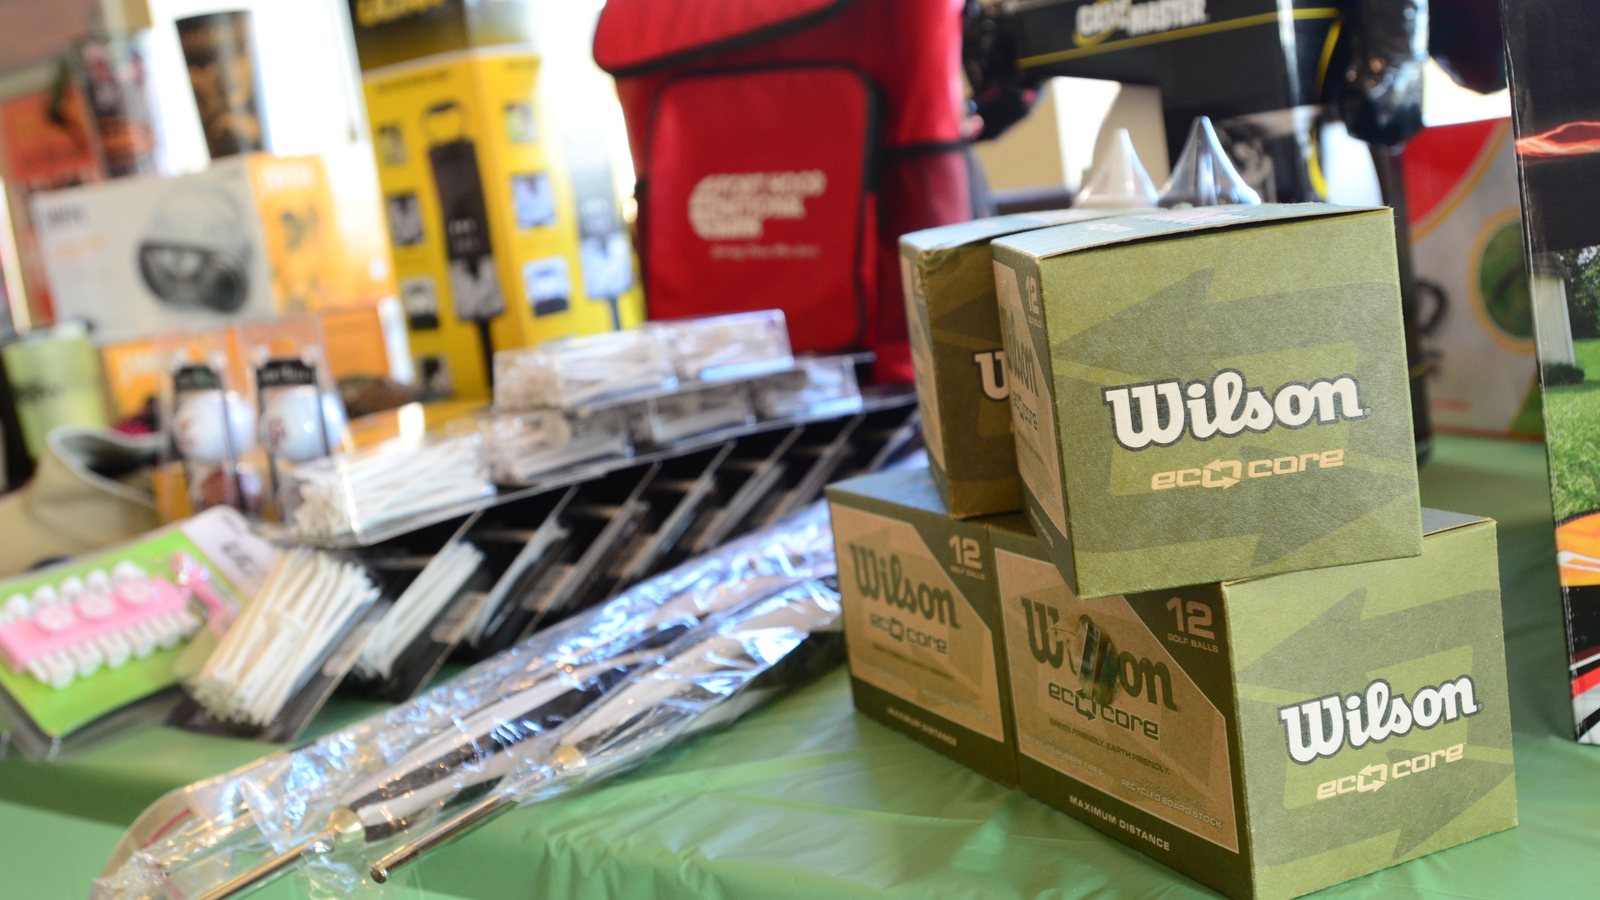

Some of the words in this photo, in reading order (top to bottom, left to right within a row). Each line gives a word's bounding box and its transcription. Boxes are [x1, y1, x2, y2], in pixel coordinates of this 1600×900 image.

[1025, 275, 1040, 315] 12
[1103, 369, 1365, 451] Wilson
[1248, 449, 1345, 479] core
[948, 535, 983, 569] 12
[850, 544, 961, 629] Wilson
[1166, 596, 1216, 640] 12
[907, 627, 948, 655] core
[1021, 596, 1178, 712] Won
[1167, 632, 1192, 645] GOLF
[1191, 638, 1219, 653] BALLS
[1101, 704, 1159, 741] core
[1278, 674, 1480, 765] Wilson
[1392, 743, 1464, 779] core
[1069, 794, 1118, 825] MAXIMUM
[1118, 818, 1171, 851] DISTANCE
[1192, 809, 1223, 830] STOCK
